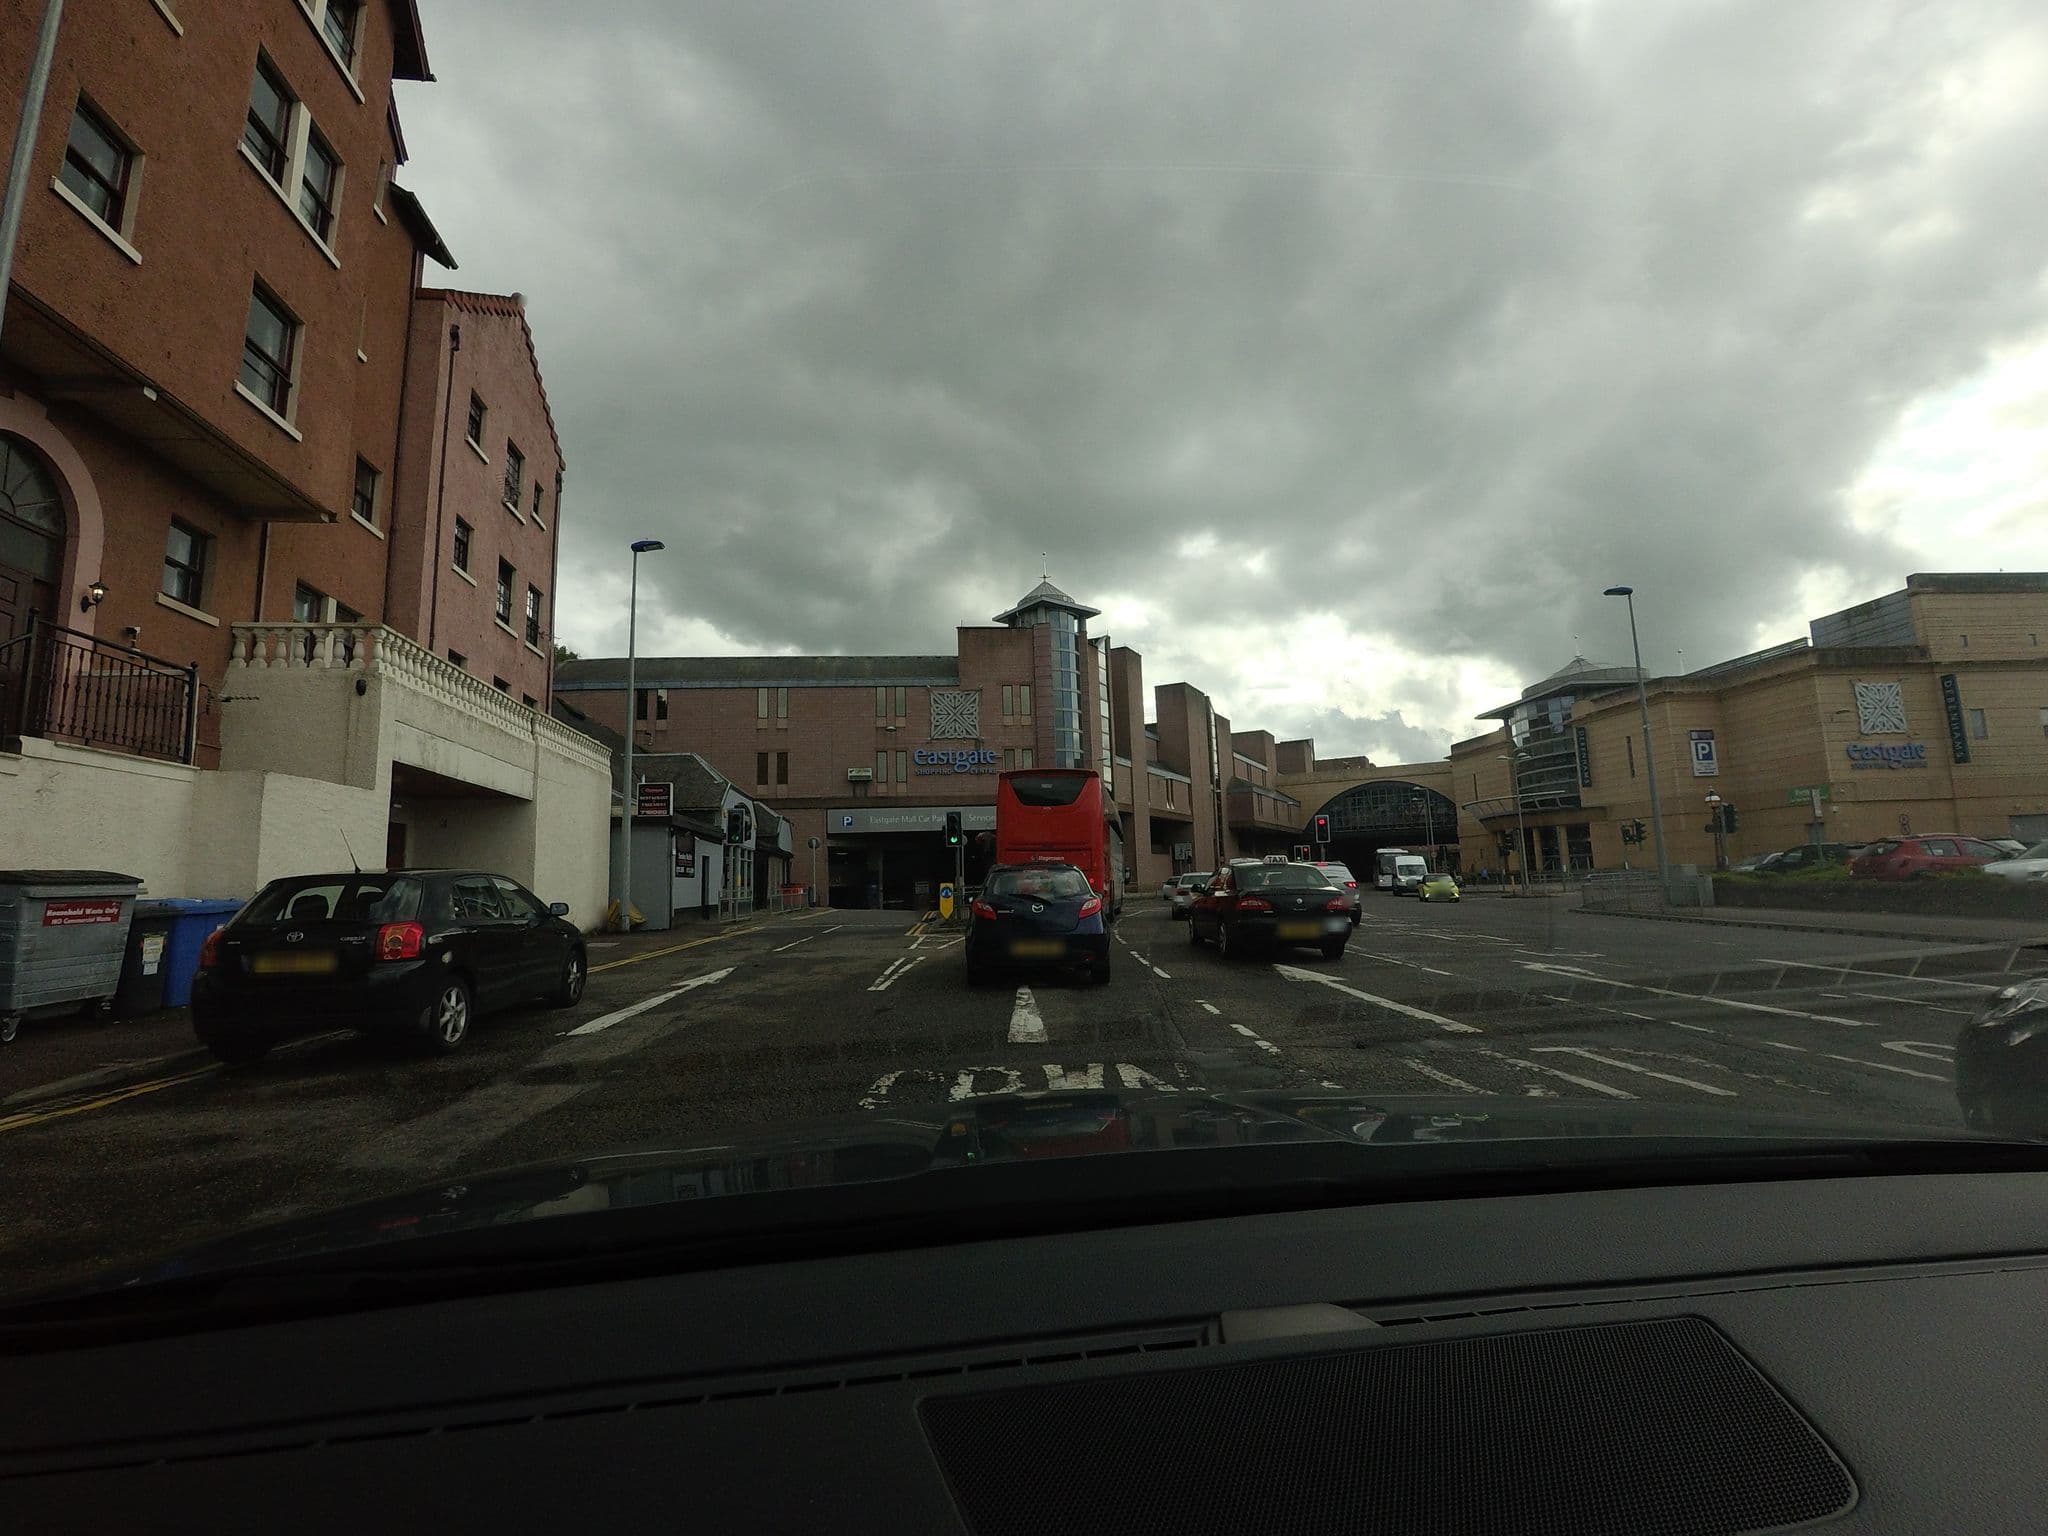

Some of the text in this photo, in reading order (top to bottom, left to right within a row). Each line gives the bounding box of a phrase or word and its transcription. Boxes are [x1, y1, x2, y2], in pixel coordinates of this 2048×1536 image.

[914, 749, 997, 773] eastgate
[1697, 743, 1710, 760] P
[1847, 744, 1927, 769] eastgate
